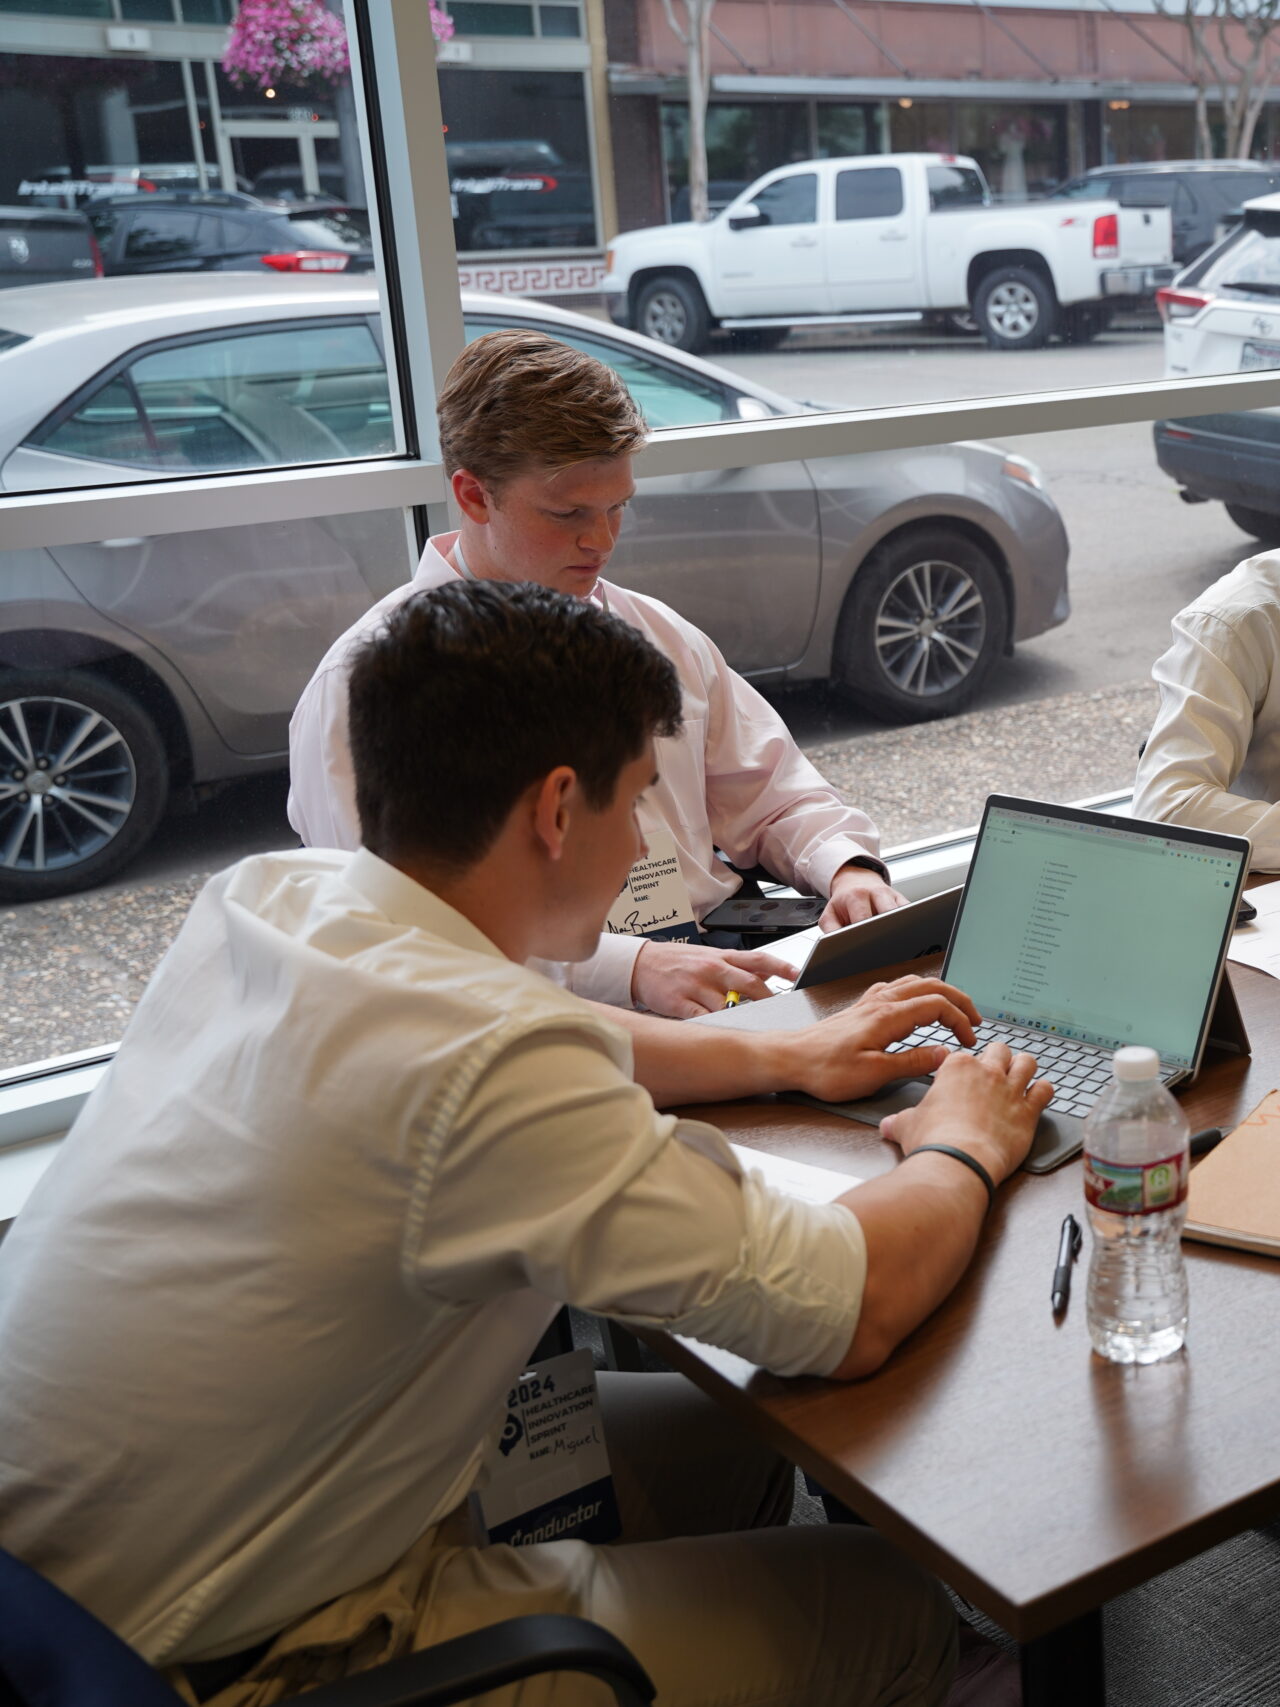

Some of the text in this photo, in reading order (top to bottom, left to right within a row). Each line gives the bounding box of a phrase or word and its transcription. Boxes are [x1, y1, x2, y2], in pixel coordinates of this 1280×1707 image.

[631, 867, 677, 882] INNOVATION
[634, 881, 659, 892] SPRINT
[508, 1376, 555, 1408] 2024
[527, 1385, 594, 1416] HEALTHCARE
[528, 1399, 593, 1430] INNOVATION
[530, 1422, 568, 1444] SPRINT
[554, 1427, 600, 1454] Miguel
[511, 1501, 602, 1545] Conductor
